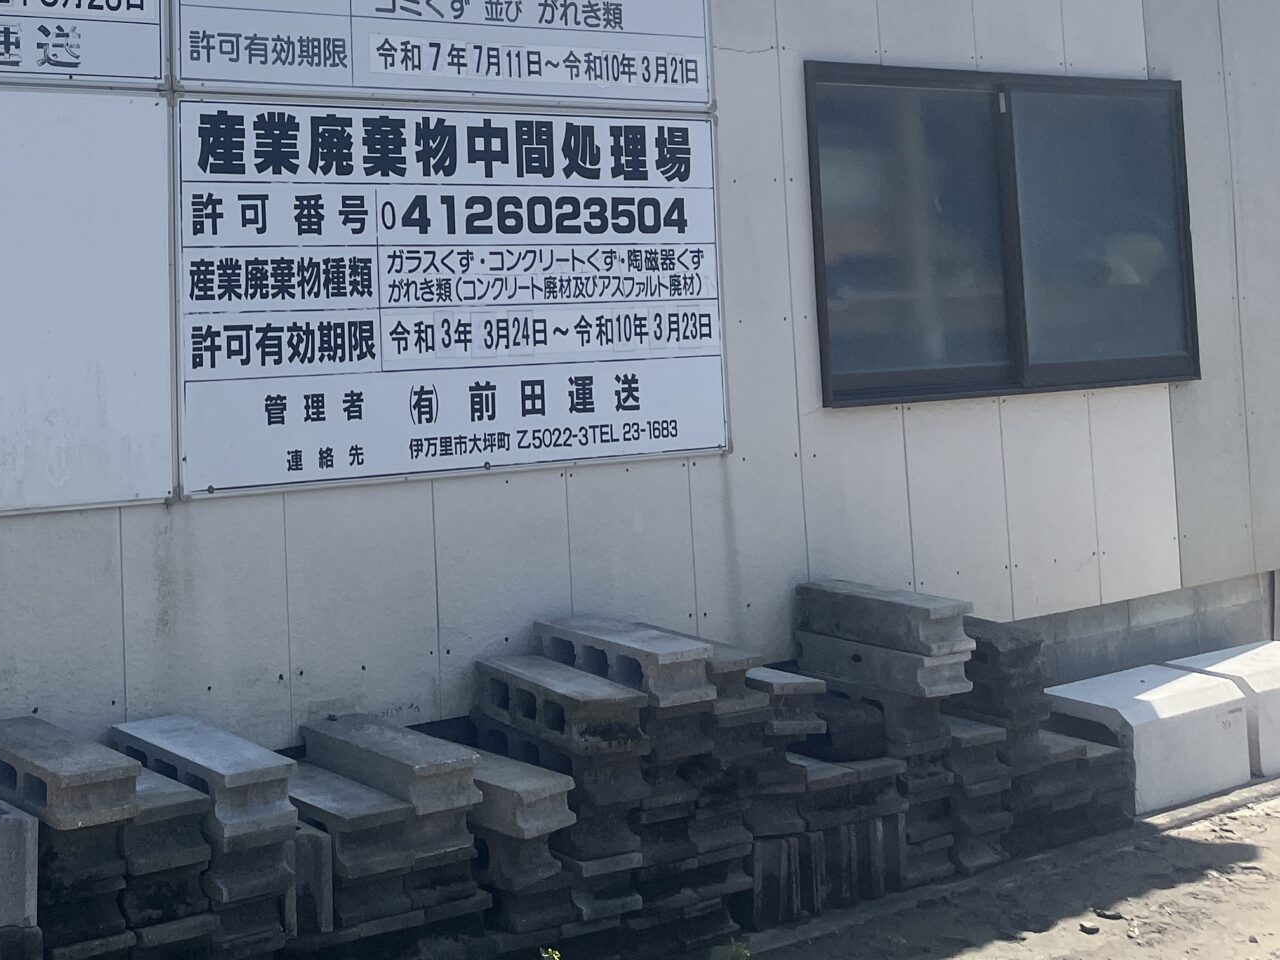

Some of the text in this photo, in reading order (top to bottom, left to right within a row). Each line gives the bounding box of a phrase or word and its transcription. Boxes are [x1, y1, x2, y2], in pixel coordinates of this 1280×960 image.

[188, 30, 348, 70] 許可有効期限
[197, 110, 692, 183] 産業廃棄物中間処理場
[191, 192, 369, 237] 許可番号
[189, 256, 373, 301] 産業廃棄物種類
[190, 321, 377, 370] 許可有効期限
[264, 390, 365, 426] 管理者
[468, 373, 642, 423] 前田運送
[286, 444, 365, 473] 連絡先
[408, 431, 511, 460] 伊万里市大坪町
[621, 418, 679, 442] 23-1683
